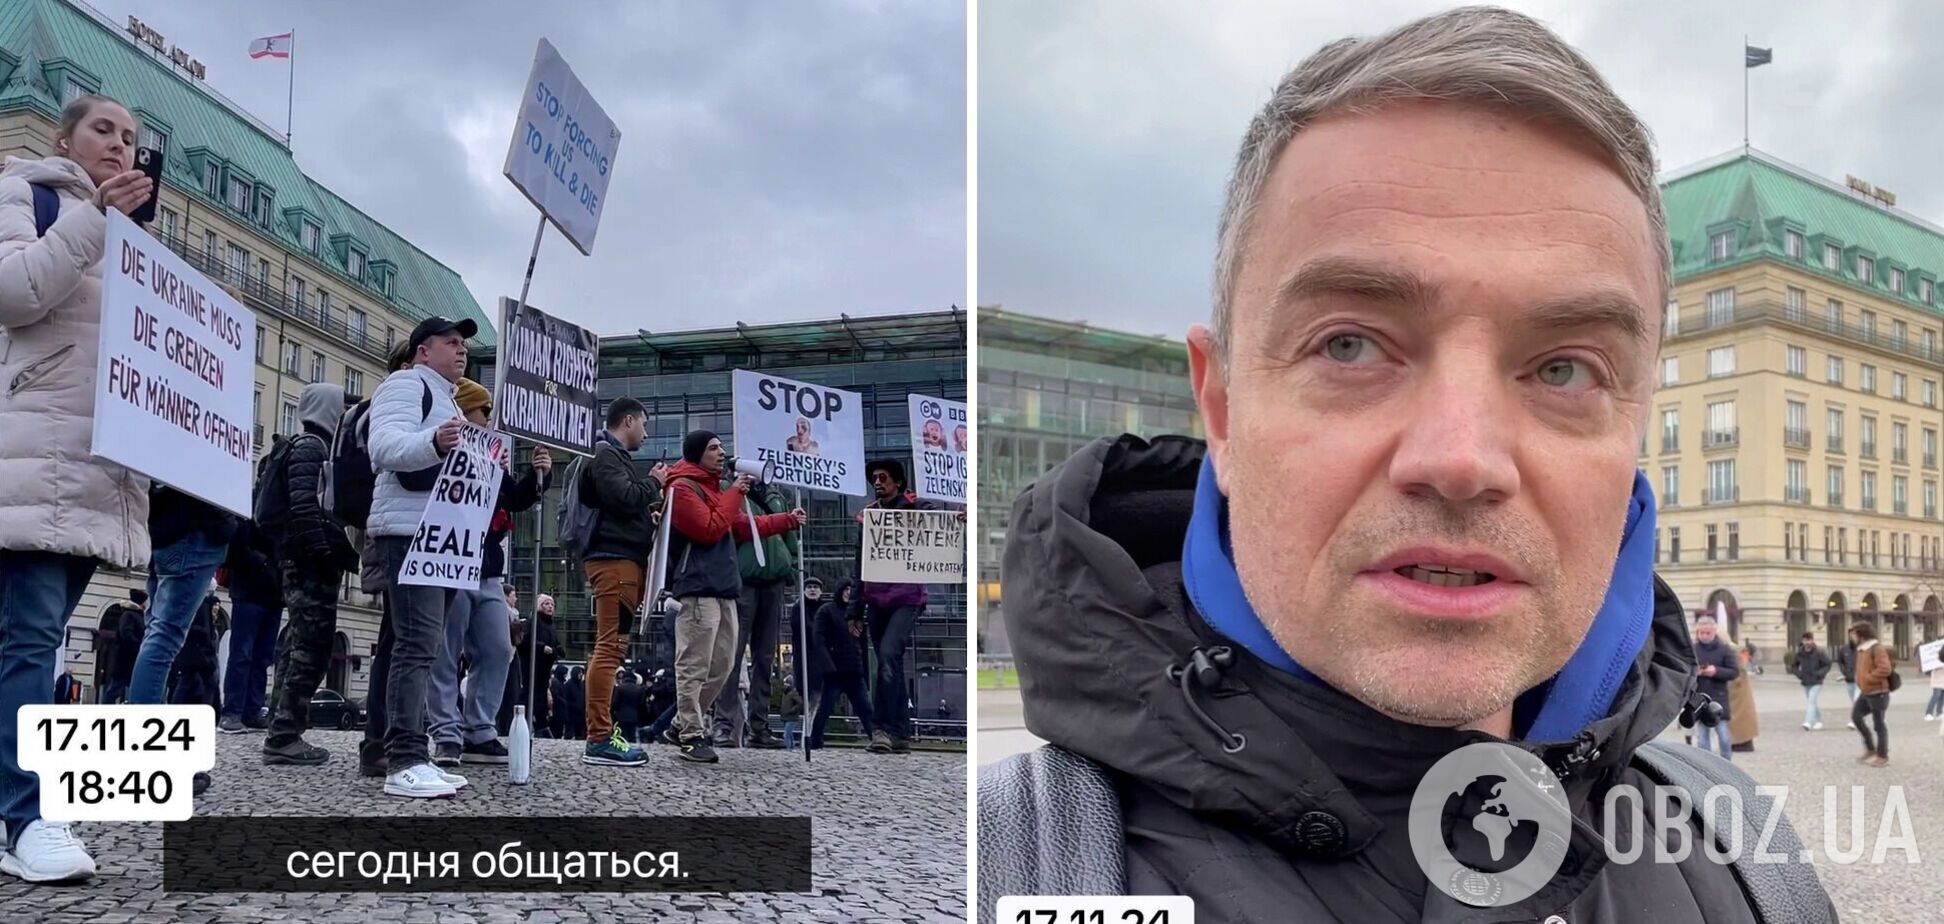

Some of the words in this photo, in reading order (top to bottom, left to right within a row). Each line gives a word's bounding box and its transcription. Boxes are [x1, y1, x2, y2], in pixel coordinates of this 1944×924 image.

[536, 81, 565, 122] STOP
[563, 114, 609, 177] FORCING
[561, 139, 574, 163] US
[525, 121, 543, 155] TO
[543, 143, 566, 185] KILL
[568, 172, 579, 194] &
[580, 186, 599, 217] DIE
[121, 238, 146, 287] DIE
[151, 259, 206, 327] UKRAINE
[210, 302, 243, 351] MUSS
[133, 305, 158, 352] DIE
[164, 326, 225, 392] GRENZEN
[553, 339, 595, 394] RIGHTS
[108, 354, 141, 408] FÜR
[145, 375, 201, 437] MÄNNER
[544, 380, 559, 397] FOR
[757, 379, 843, 422] STOP
[502, 382, 567, 441] UKRAINIAN
[567, 401, 593, 449] MEN
[757, 447, 847, 476] ZELENSKY'S
[924, 451, 953, 478] STOP
[772, 465, 840, 489] ORTURES
[435, 478, 482, 507] ROM
[869, 511, 904, 528] WER
[906, 511, 936, 530] HAT
[410, 520, 474, 558] REAL
[870, 546, 914, 561] RECHTE
[404, 559, 418, 576] IS
[422, 561, 465, 580] ONLY
[402, 772, 415, 785] FILA
